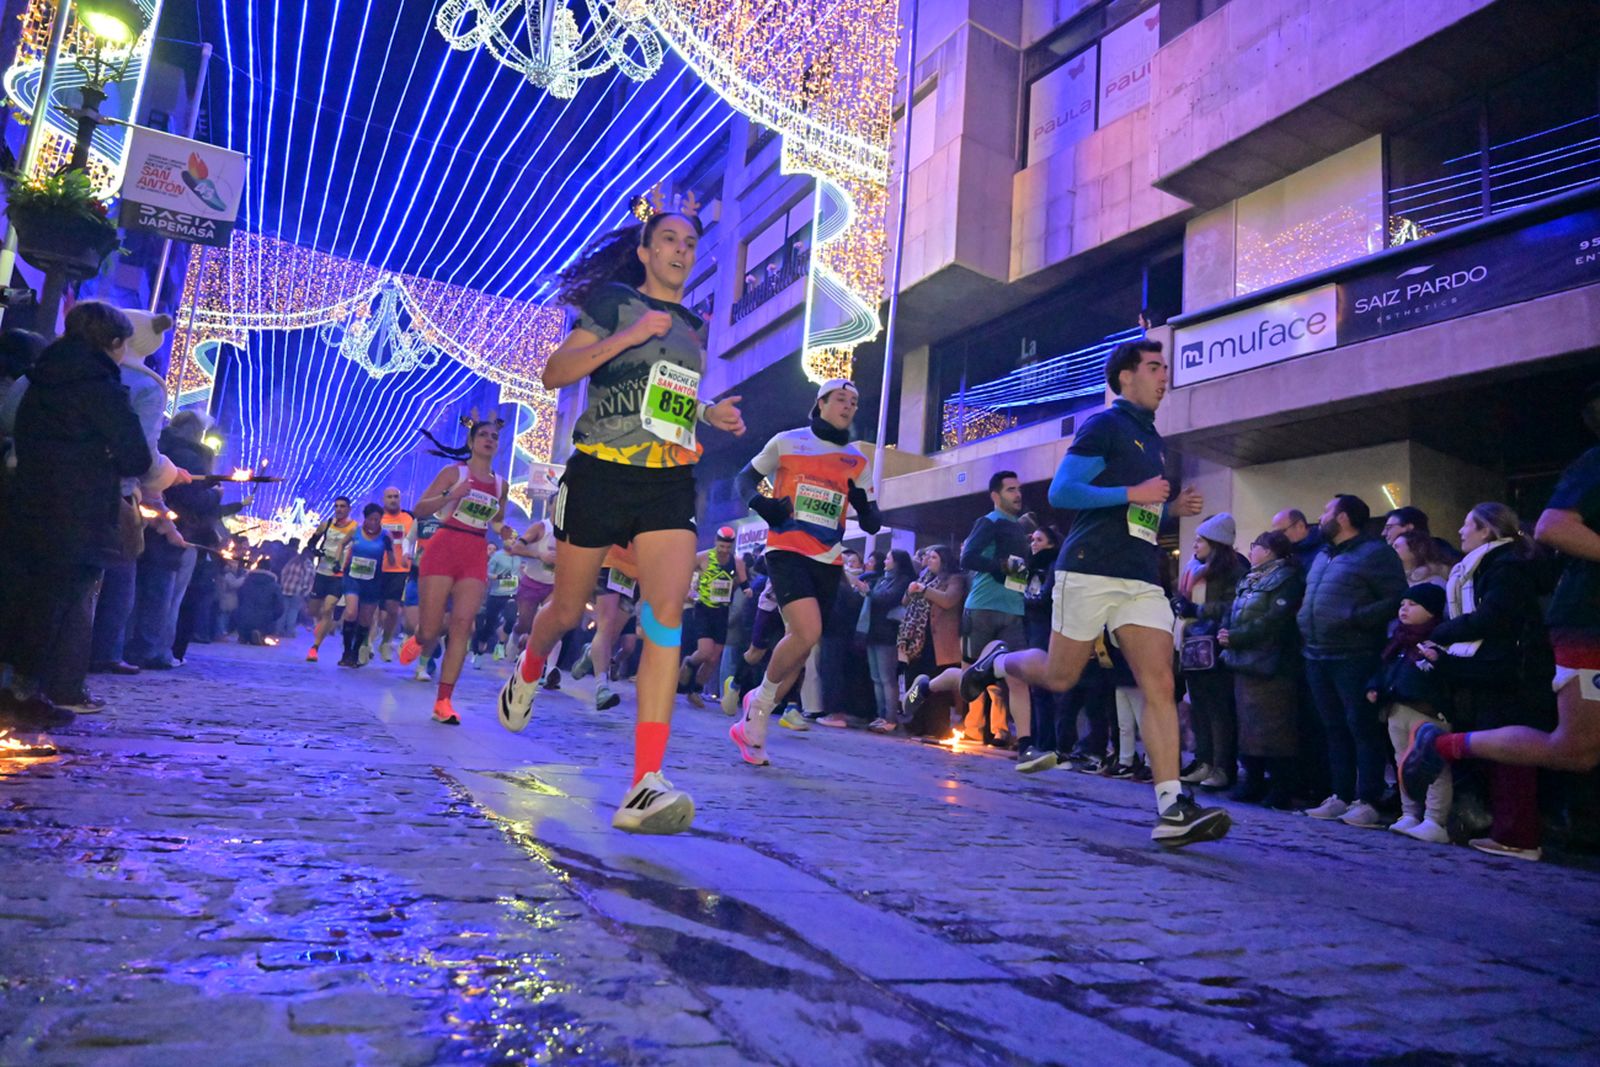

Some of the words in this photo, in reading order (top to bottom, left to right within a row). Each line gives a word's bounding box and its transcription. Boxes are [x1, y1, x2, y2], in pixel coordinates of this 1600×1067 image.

[140, 166, 171, 181] SAN
[138, 216, 214, 239] JAPEMASA
[139, 204, 216, 230] DACIA
[1354, 288, 1400, 314] SAIZ
[1406, 265, 1488, 300] PARDO
[1021, 337, 1037, 359] La
[1209, 312, 1327, 364] muface
[657, 377, 673, 389] SAN
[667, 372, 689, 386] NOCHE
[803, 498, 838, 516] 4345
